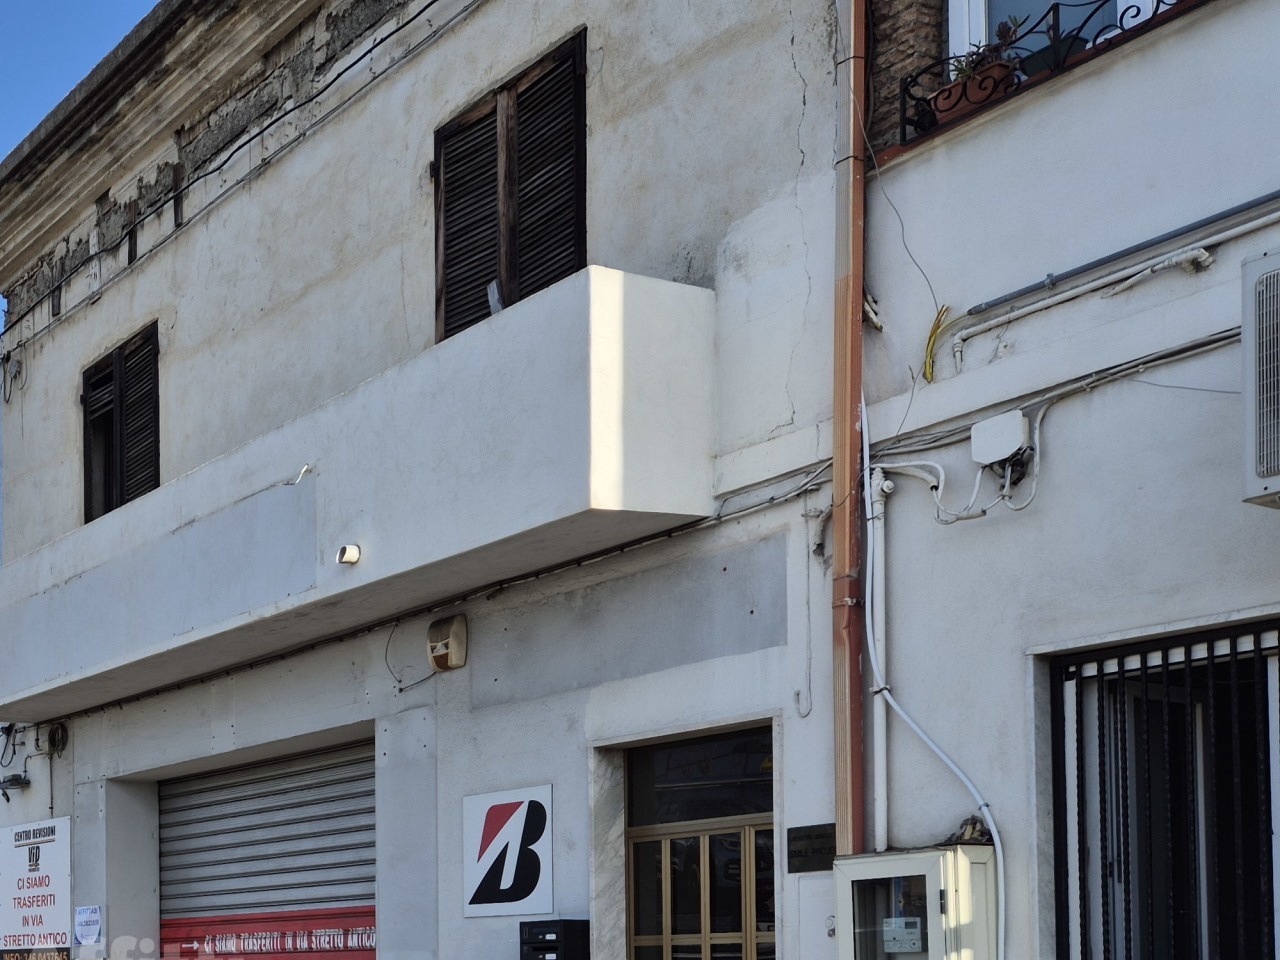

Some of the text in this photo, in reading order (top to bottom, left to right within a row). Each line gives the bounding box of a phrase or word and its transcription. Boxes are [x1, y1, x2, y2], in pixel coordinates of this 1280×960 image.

[14, 825, 56, 842] CENTRO REVISIONI
[17, 875, 50, 890] CI SIAMO
[12, 893, 56, 909] TRASFERITI
[22, 914, 44, 928] IN VIA
[3, 931, 68, 947] STRETTO ANTICO
[204, 926, 376, 953] CI SIAMO TRASFERITI IN VIA STRETTO ANTICO
